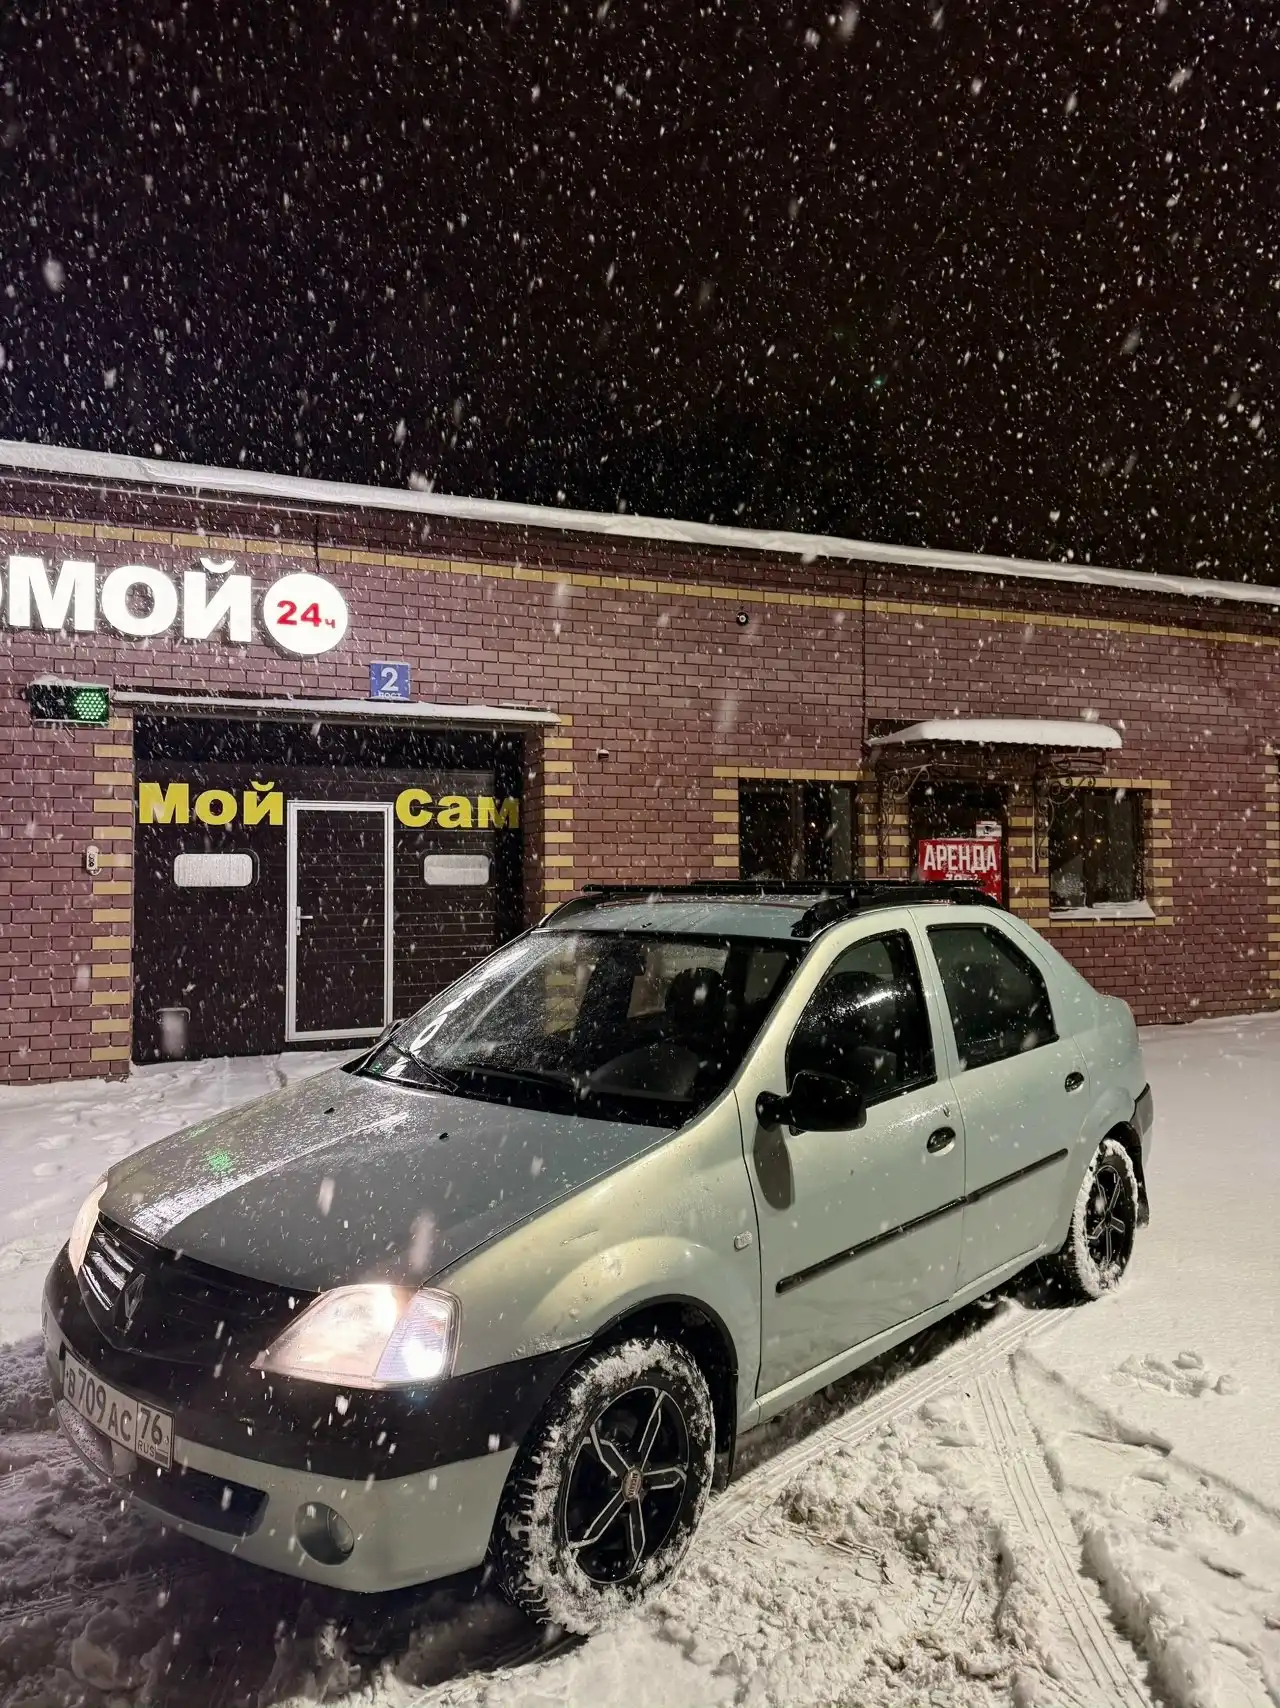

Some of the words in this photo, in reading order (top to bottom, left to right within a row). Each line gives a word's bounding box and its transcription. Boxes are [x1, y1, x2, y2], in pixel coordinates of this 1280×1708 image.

[0, 555, 251, 643] МОЙ
[381, 667, 399, 692] 2
[138, 780, 284, 826] Мой
[395, 788, 520, 829] Сам
[923, 844, 998, 873] АРЕНДА
[137, 1440, 156, 1457] RUS
